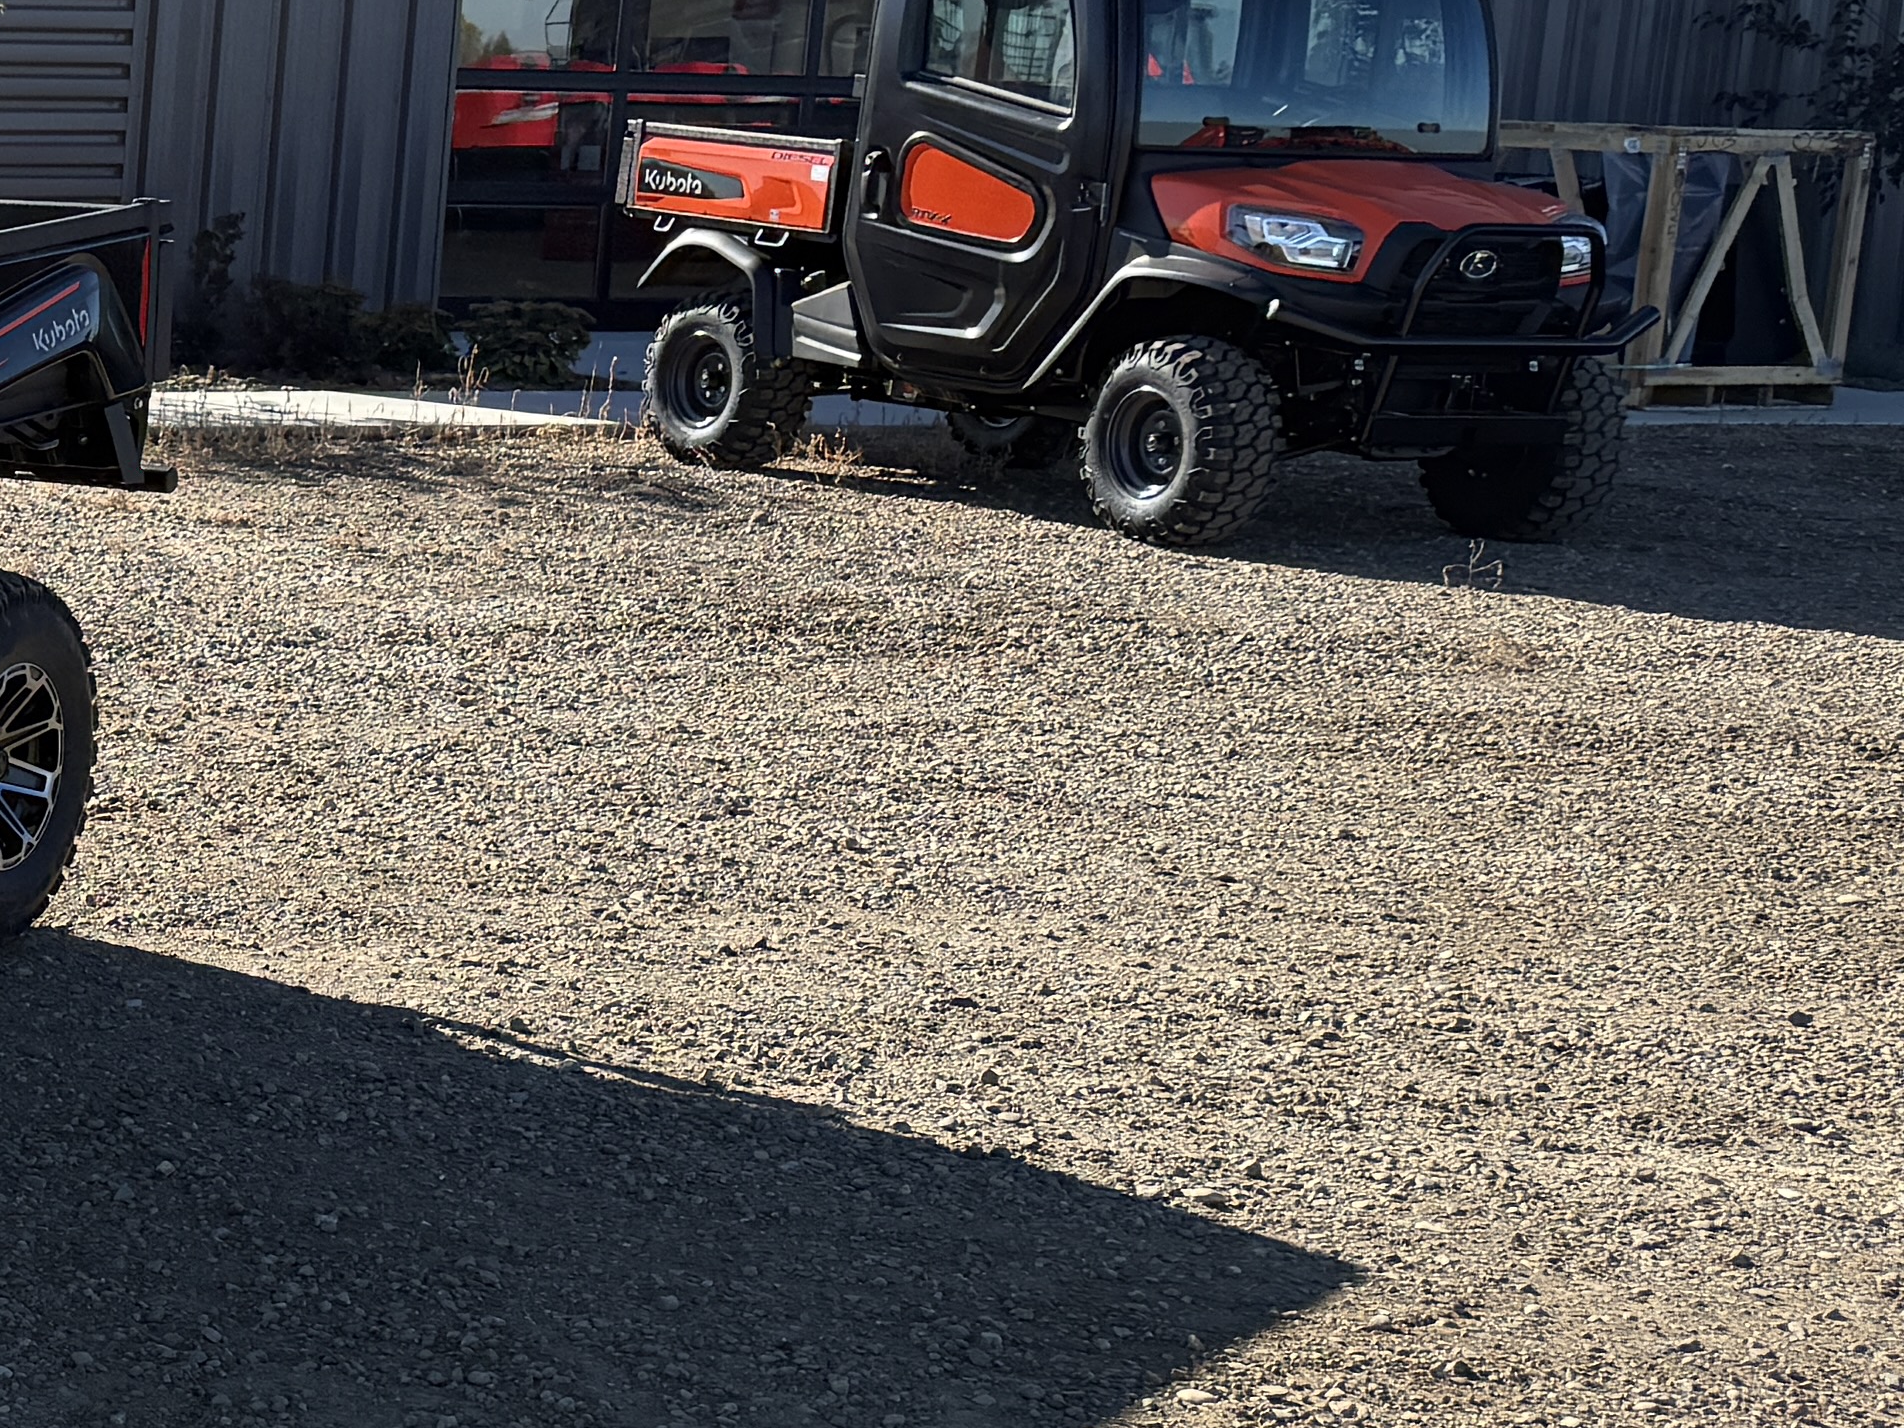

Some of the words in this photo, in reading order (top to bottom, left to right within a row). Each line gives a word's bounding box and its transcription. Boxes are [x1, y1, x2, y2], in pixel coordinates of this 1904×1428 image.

[771, 151, 829, 166] DIESEL
[645, 168, 702, 194] Kubota
[32, 308, 90, 352] Kubota
